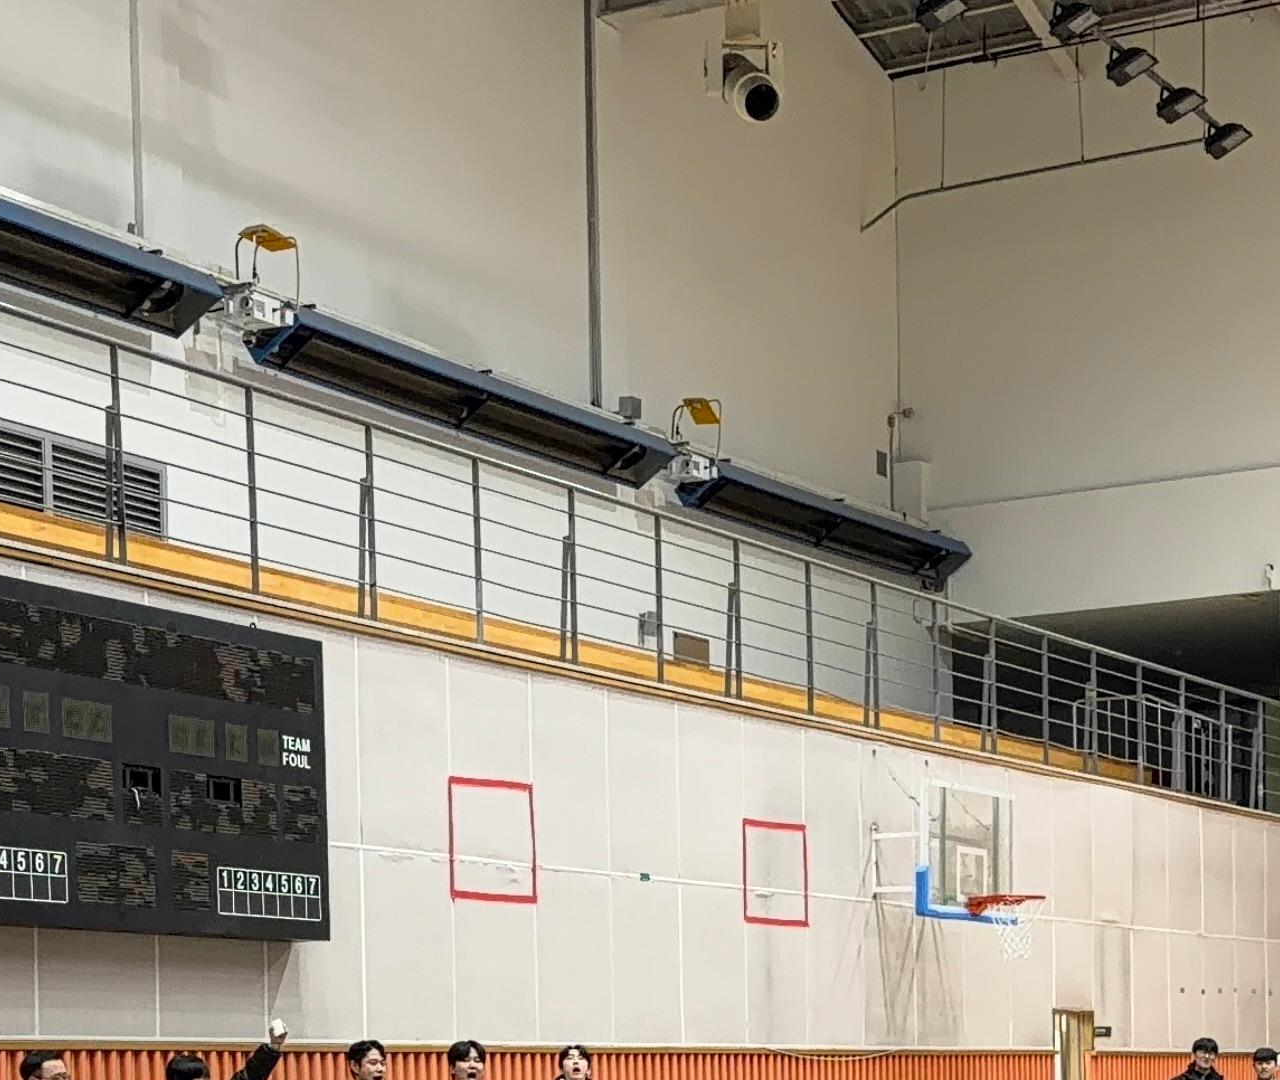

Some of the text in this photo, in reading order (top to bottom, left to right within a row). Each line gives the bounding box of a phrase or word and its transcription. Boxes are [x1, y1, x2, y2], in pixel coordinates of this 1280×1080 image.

[282, 734, 311, 753] TEAM
[282, 751, 312, 769] FOUL
[16, 851, 26, 872] 5
[35, 852, 45, 873] 6
[53, 854, 63, 874] 7
[222, 870, 317, 895] 1 2 3 4 5 6 7
